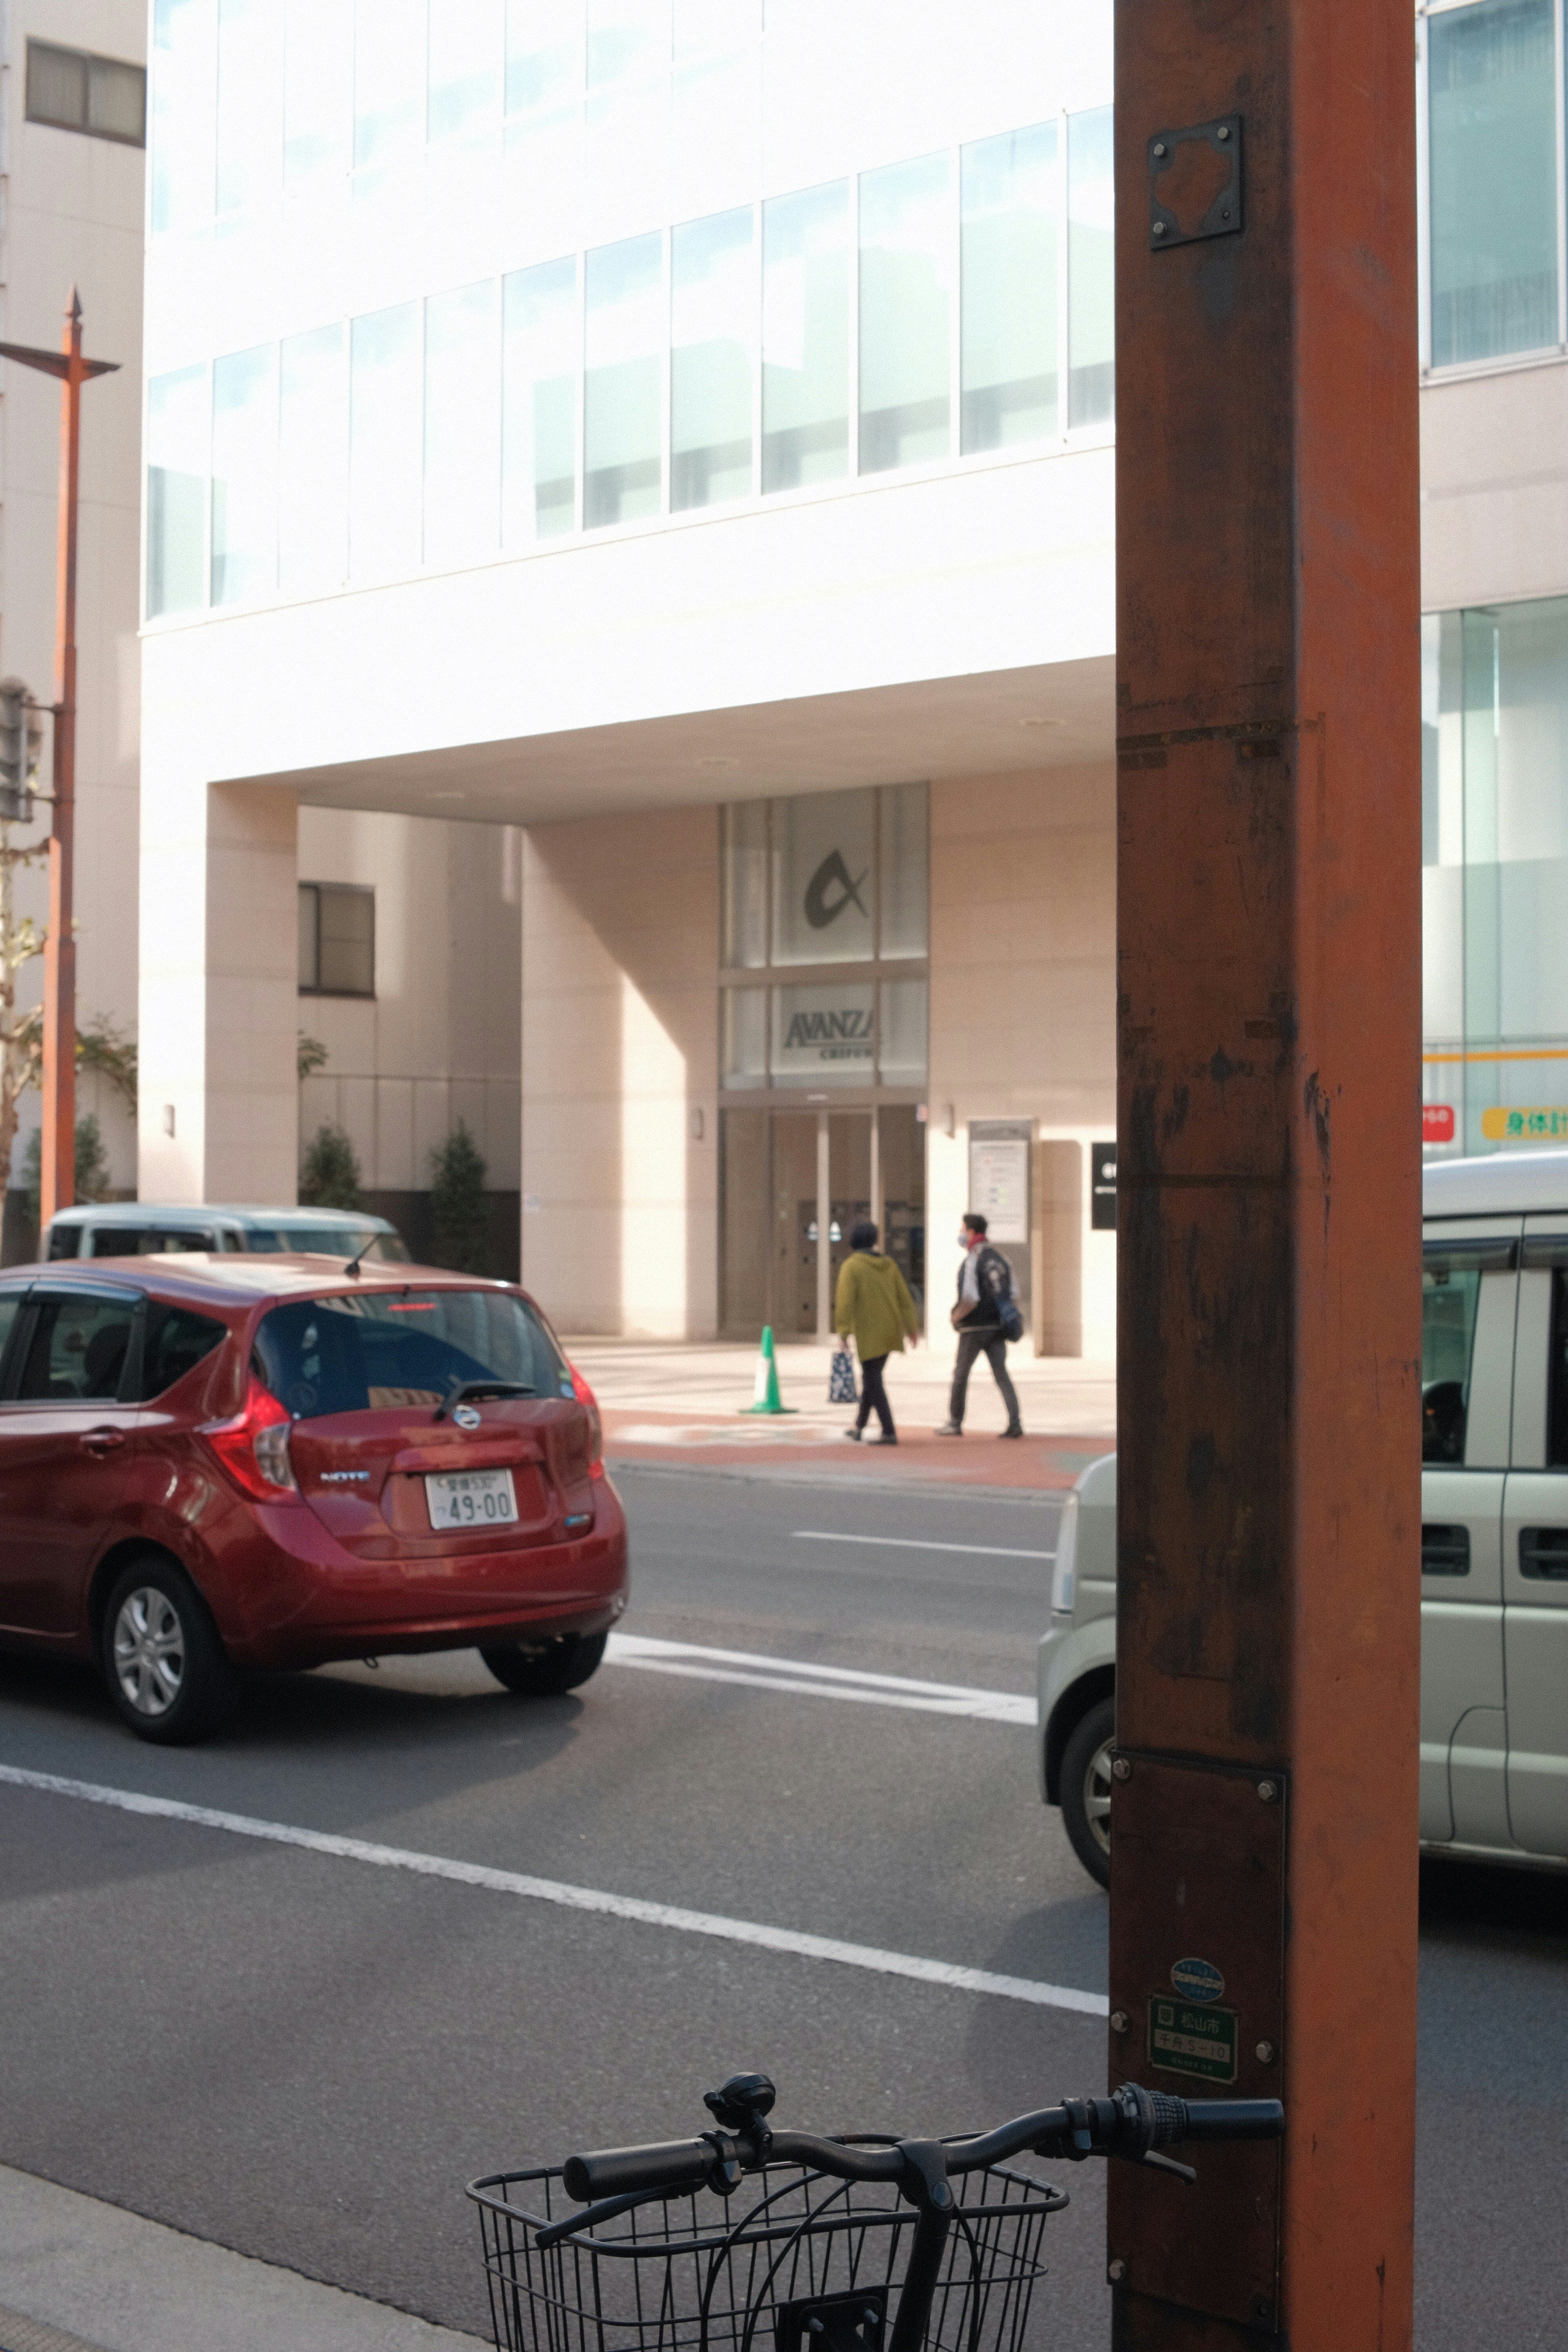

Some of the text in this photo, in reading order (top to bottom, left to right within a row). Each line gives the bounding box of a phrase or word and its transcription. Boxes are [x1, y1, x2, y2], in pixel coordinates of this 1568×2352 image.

[320, 1471, 370, 1482] NOTE
[1181, 2012, 1220, 2034] 松山市
